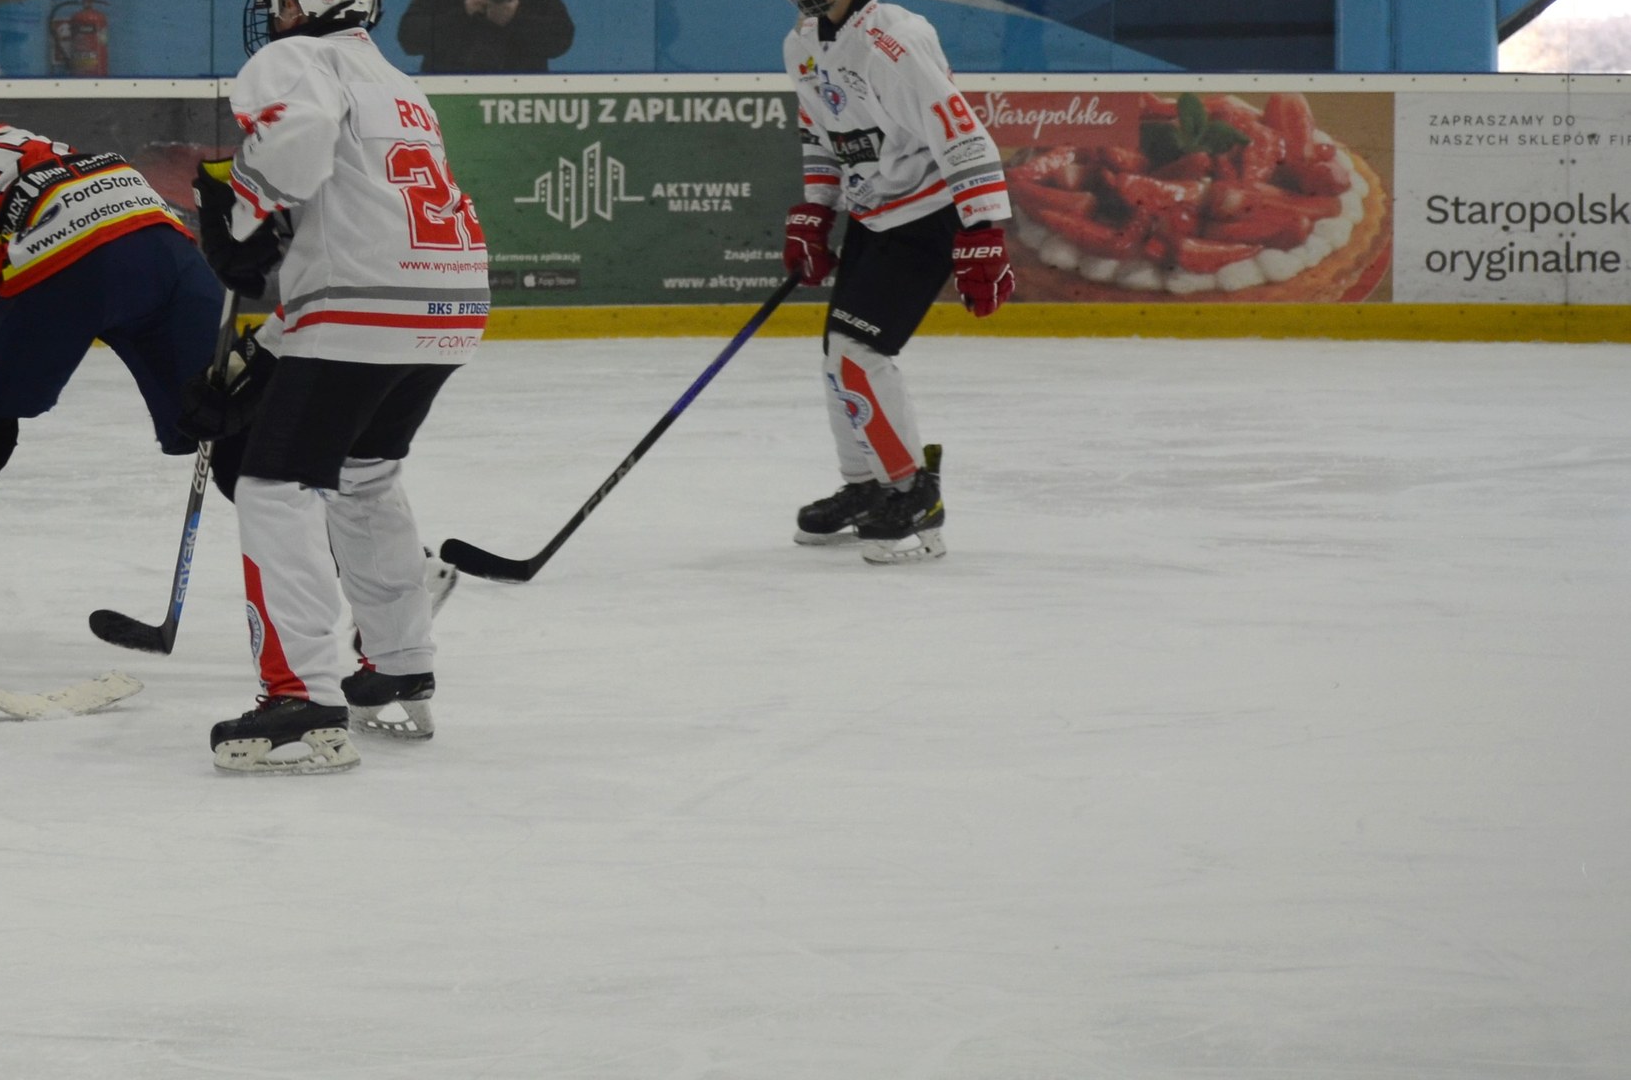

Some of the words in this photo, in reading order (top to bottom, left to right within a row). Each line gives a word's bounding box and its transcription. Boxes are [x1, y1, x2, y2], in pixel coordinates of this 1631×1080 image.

[479, 98, 590, 130] TRENUJ
[598, 98, 617, 123] Z
[624, 97, 787, 130] APLIKACJĄ
[932, 94, 976, 141] 19
[972, 92, 1118, 140] Staropolska
[1429, 114, 1544, 127] ZAPRASZAMY
[1553, 114, 1576, 127] DO
[1429, 134, 1509, 146] NASZYCH
[1518, 131, 1601, 146] SKLEPÓW
[61, 173, 142, 209] FordStore
[651, 183, 752, 198] AKTYWNE
[668, 198, 733, 212] MIASTA
[1426, 192, 1631, 232] Staropolsk
[1425, 241, 1621, 281] oryginalne
[428, 303, 452, 315] BKS
[176, 527, 198, 604] NEXUS
